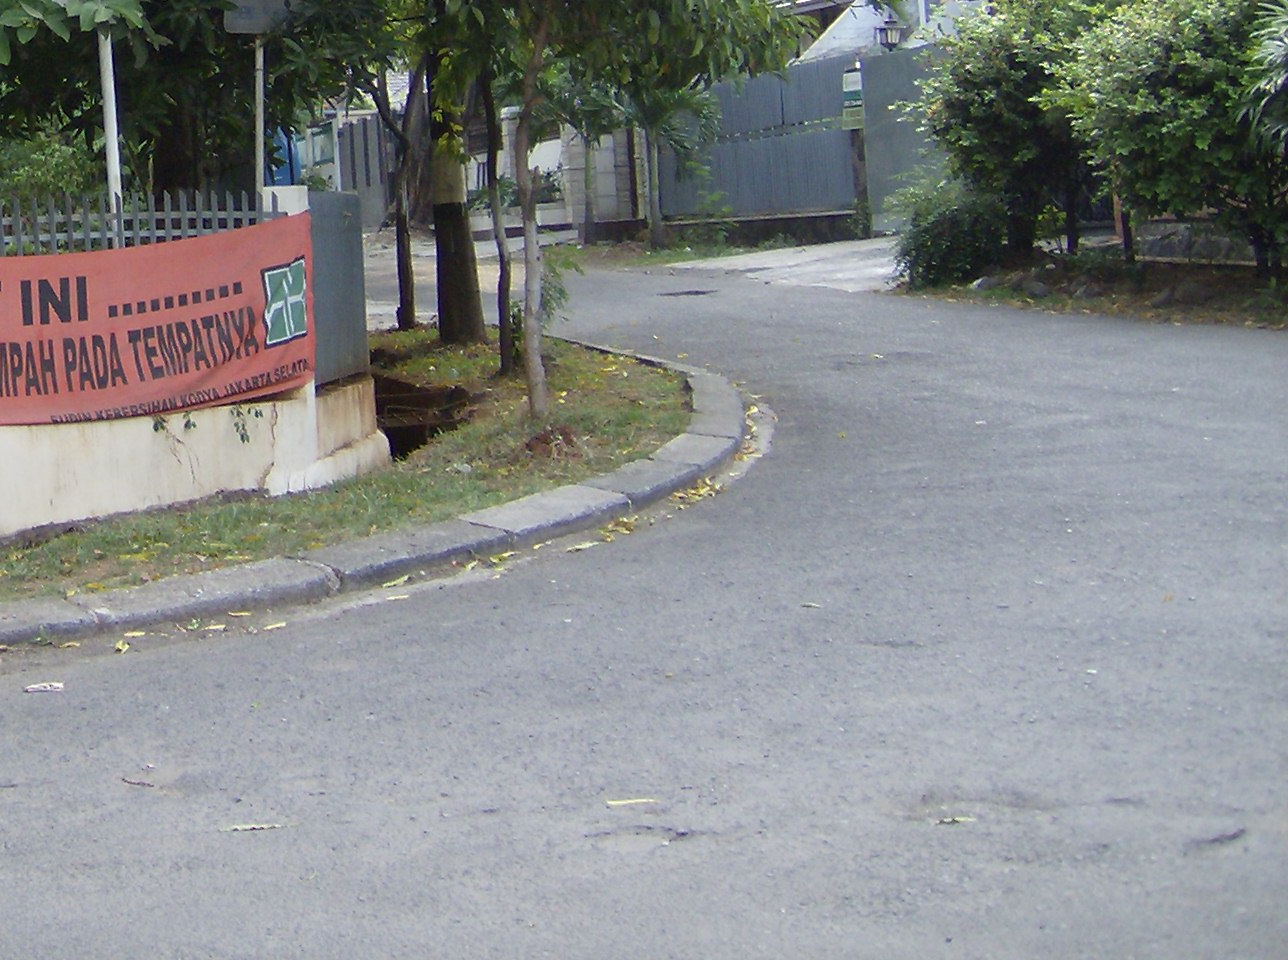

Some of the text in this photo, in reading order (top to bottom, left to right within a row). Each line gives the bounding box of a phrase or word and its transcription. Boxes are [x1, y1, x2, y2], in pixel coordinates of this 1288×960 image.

[20, 275, 89, 326] INI
[63, 332, 128, 392] PADA
[128, 305, 260, 382] TEMPATNYA
[224, 373, 272, 398] JAKARTA
